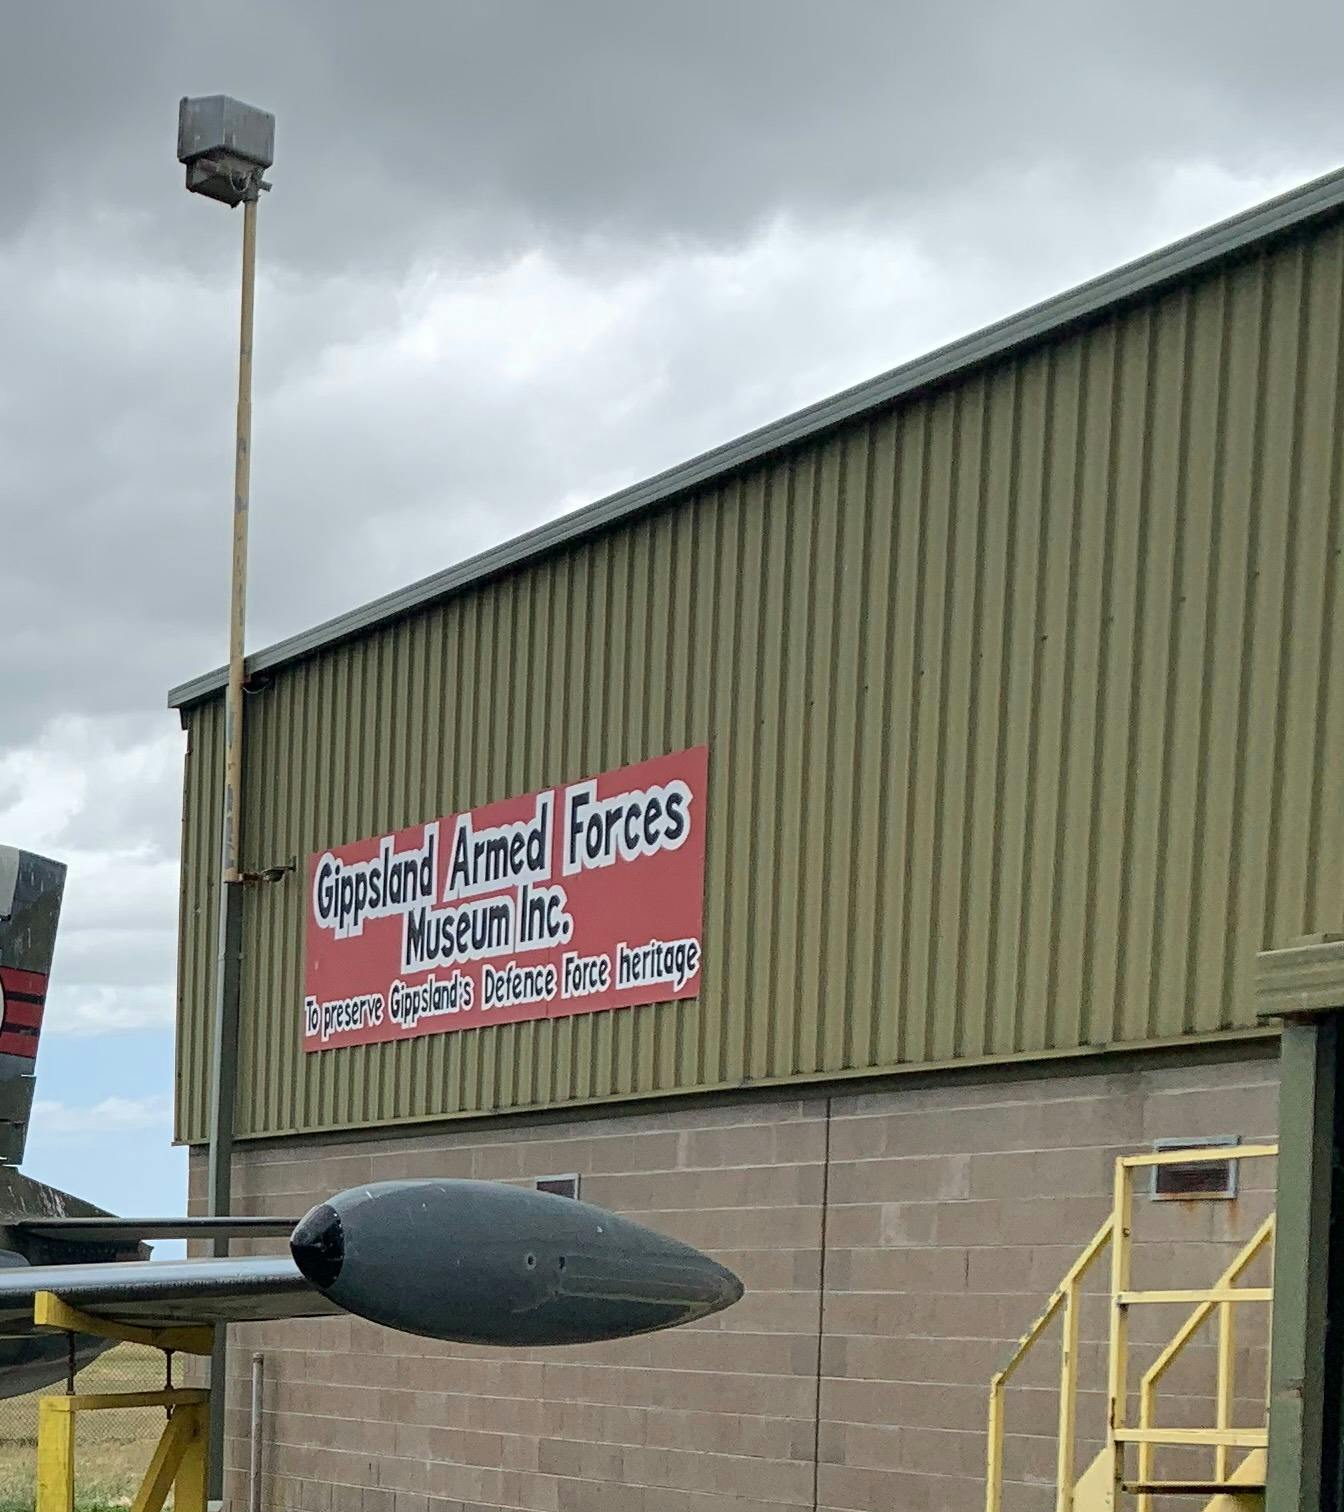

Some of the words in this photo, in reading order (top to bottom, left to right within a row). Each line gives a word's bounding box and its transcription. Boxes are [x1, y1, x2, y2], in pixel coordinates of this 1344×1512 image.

[317, 833, 435, 930] Gippsland
[449, 802, 549, 891] Armed
[569, 791, 685, 865] Forces
[405, 902, 511, 966] Museum
[519, 884, 571, 944] Inc.
[305, 1000, 320, 1031] To
[323, 995, 383, 1037] preserve
[390, 973, 472, 1024] Gippsland's
[484, 965, 555, 1005] Defence
[564, 955, 609, 994] Force
[618, 941, 699, 987] heritage
